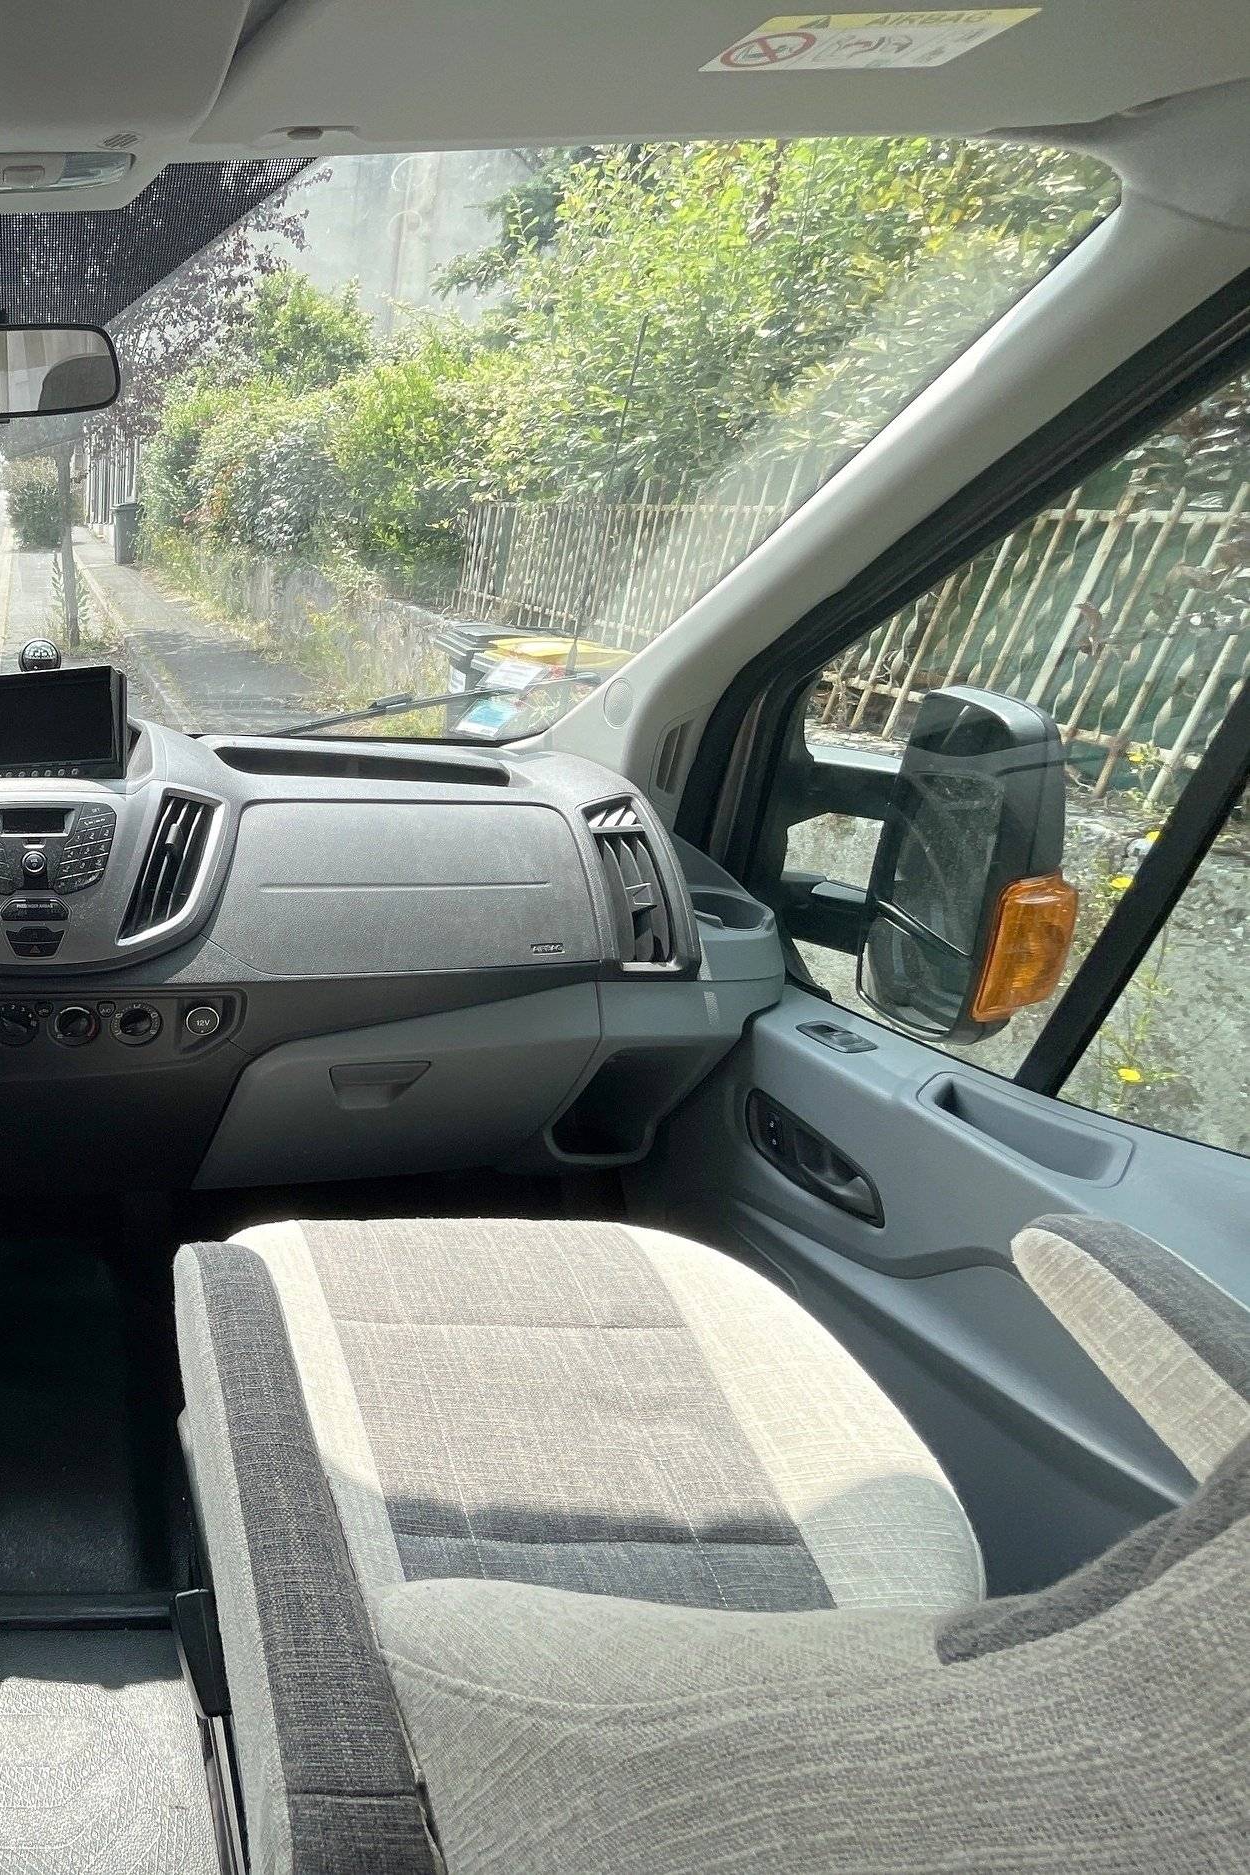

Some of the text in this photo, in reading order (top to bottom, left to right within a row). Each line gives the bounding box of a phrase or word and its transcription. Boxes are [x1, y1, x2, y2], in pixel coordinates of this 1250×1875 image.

[864, 9, 992, 26] AIRBAG
[532, 944, 563, 952] AIRBAG
[196, 1019, 211, 1027] 12V
